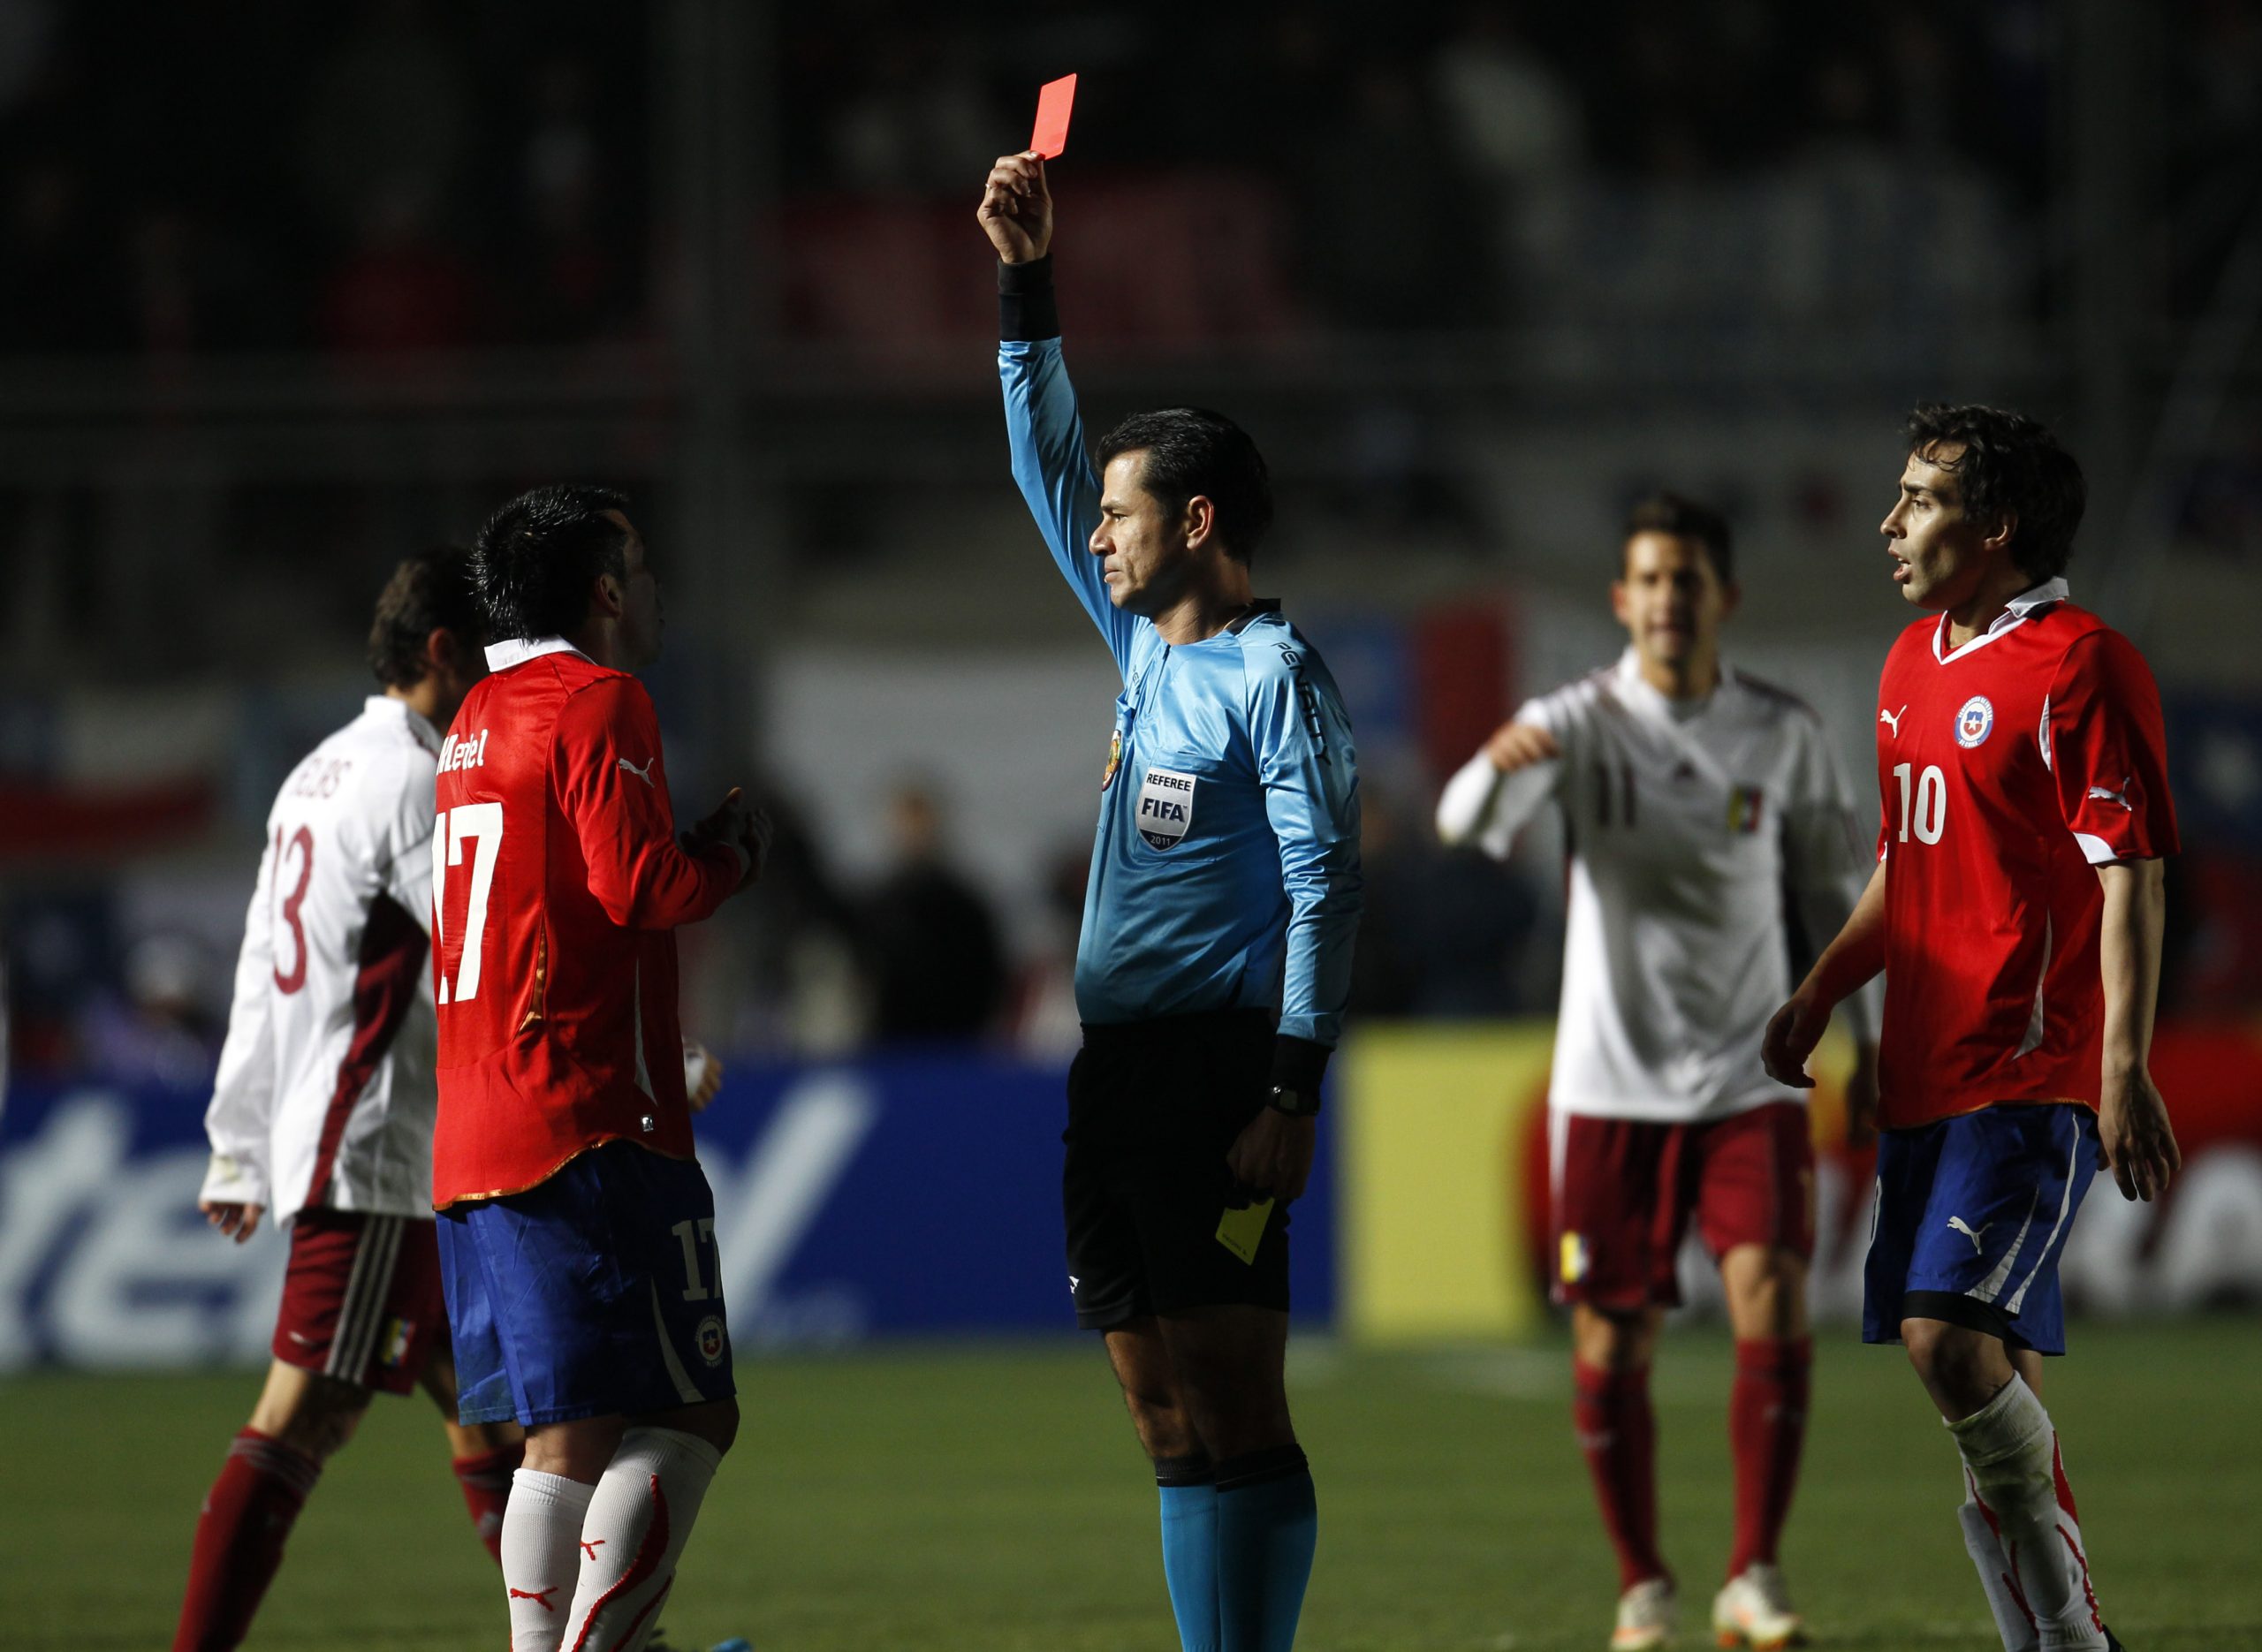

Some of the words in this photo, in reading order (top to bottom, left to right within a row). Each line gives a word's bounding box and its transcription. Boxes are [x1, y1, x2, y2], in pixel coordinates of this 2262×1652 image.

[1146, 773, 1192, 792] REFEREE
[1596, 758, 1636, 828] 11
[1894, 762, 1947, 845] 10
[1141, 797, 1186, 822] FIFA
[1150, 835, 1171, 846] 2011
[431, 801, 504, 1004] 17
